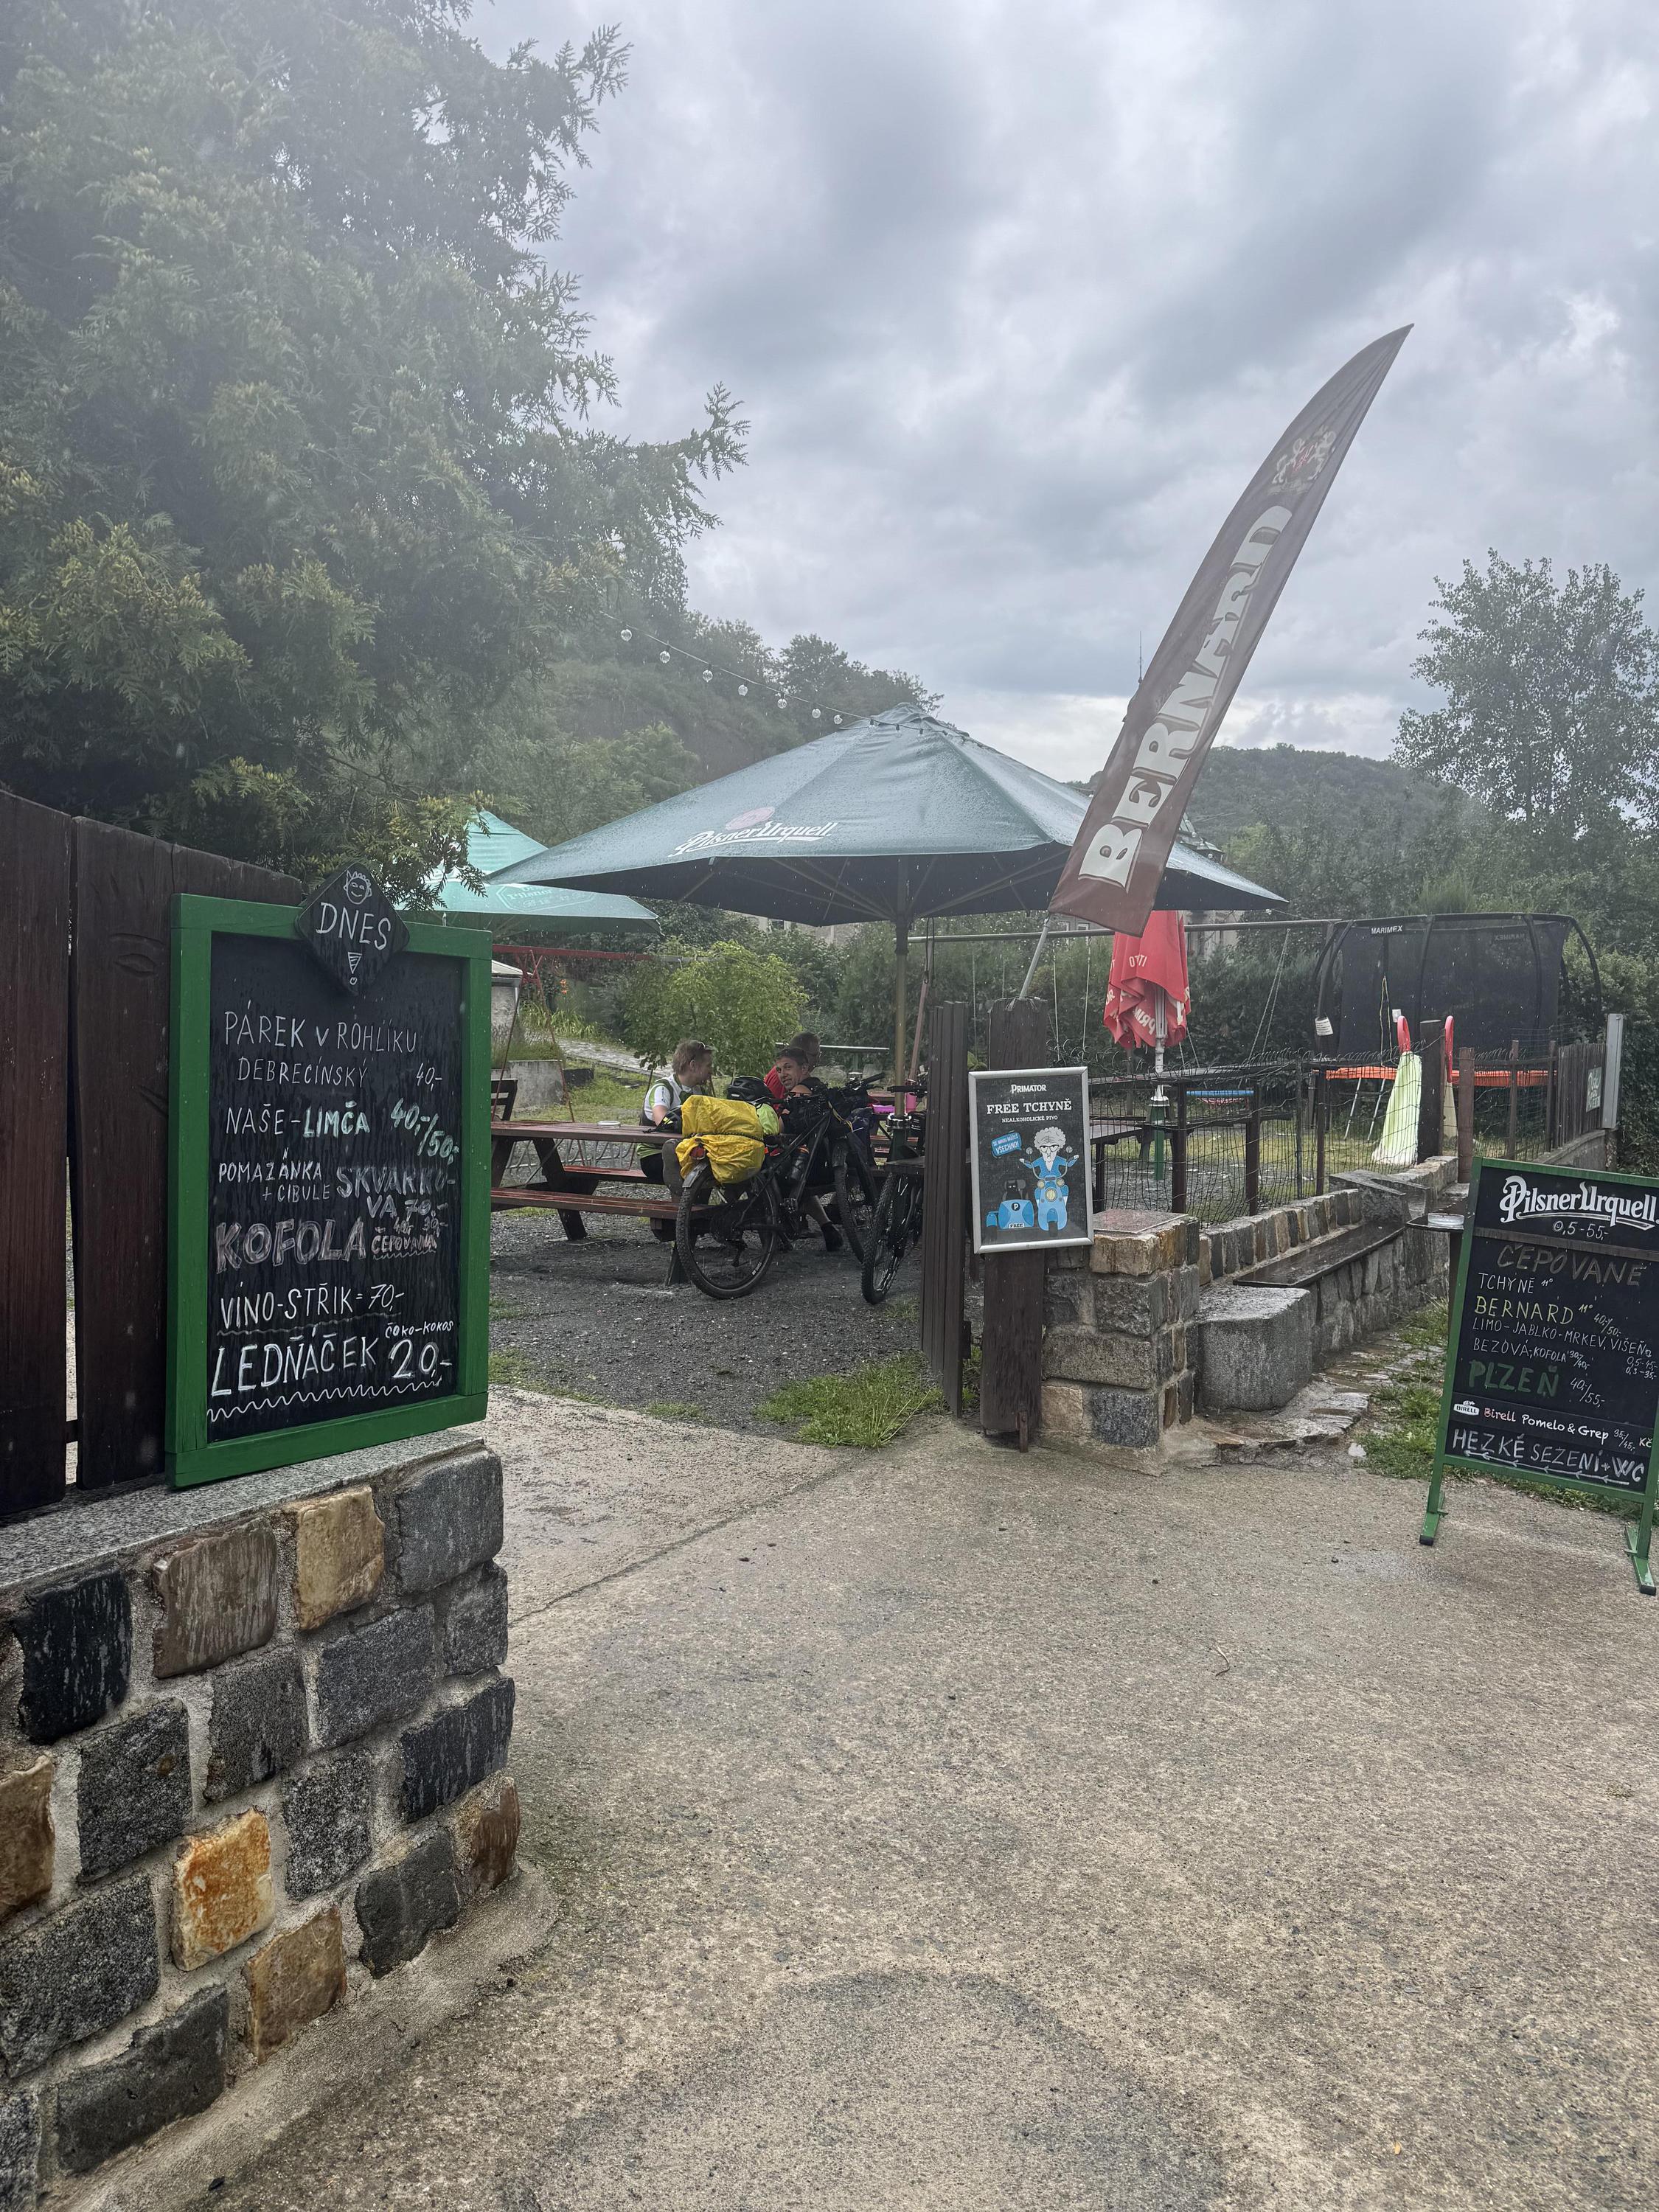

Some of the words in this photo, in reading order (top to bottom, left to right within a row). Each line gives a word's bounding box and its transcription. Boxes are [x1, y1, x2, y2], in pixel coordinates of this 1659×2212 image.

[1078, 505, 1293, 891] BERNARD
[667, 830, 761, 858] Pilsner
[316, 902, 392, 950] DNES
[1371, 925, 1403, 934] MARIMEX
[225, 1000, 306, 1048] PÁREK
[337, 1018, 417, 1054] ROHLÍKU
[237, 1056, 368, 1088] DEBRECÍNSKÝ
[987, 1103, 1020, 1114] FREE
[1023, 1098, 1072, 1113] TCHYNĚ
[219, 1147, 323, 1183] POMAZÁNKA
[262, 1186, 272, 1201] +
[277, 1184, 331, 1203] CIBULE
[366, 1194, 398, 1219] VA
[1500, 1175, 1582, 1223] Pilsner
[216, 1217, 366, 1274] KOFOLA
[1474, 1295, 1573, 1325] BERNARD
[211, 1327, 380, 1397] LEDŇÁČEK
[1469, 1360, 1559, 1397] PLZEŇ
[1456, 1405, 1477, 1413] BIRELL
[1484, 1407, 1516, 1422] Birell
[1522, 1414, 1565, 1432] Pomelo
[1568, 1423, 1576, 1435] &
[1578, 1425, 1609, 1445] Grep
[1639, 1437, 1652, 1448] Kč
[1612, 1456, 1645, 1482] WC
